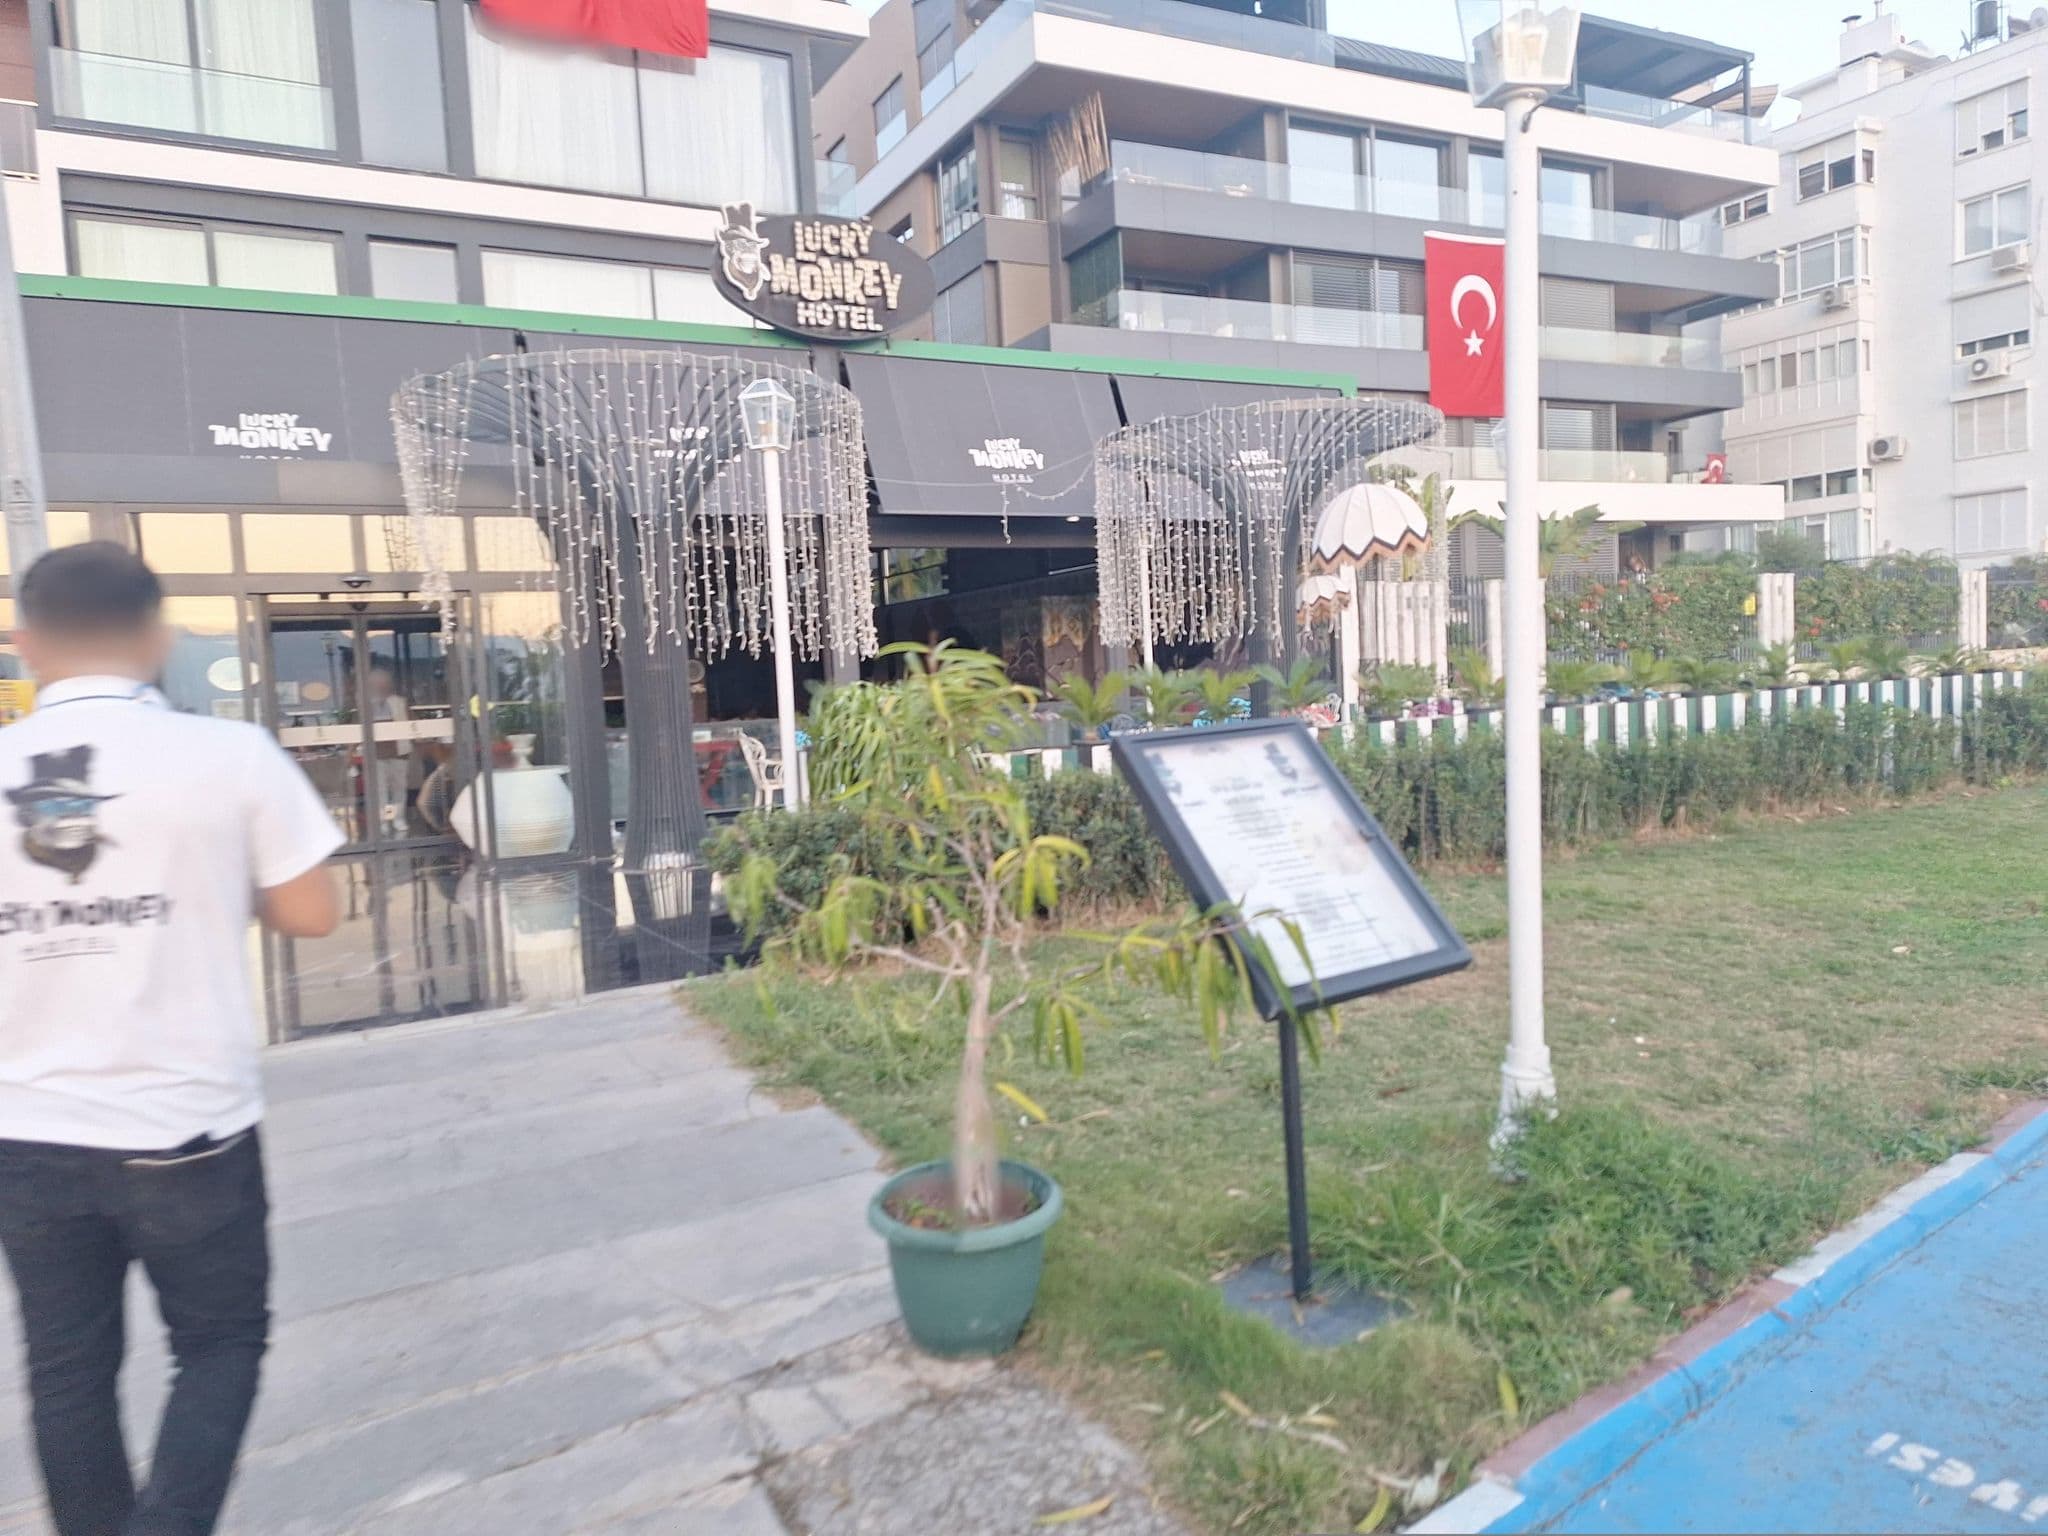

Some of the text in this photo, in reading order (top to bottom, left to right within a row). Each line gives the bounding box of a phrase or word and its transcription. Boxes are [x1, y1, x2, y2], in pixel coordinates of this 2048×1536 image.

[794, 219, 873, 262] LUCKY
[769, 253, 902, 310] MONKEY
[796, 301, 884, 331] HOTEL
[239, 413, 299, 430] LUCKY
[208, 424, 332, 452] MONKEY
[984, 438, 1021, 453] LUCKY
[968, 448, 1044, 470] MONKEY
